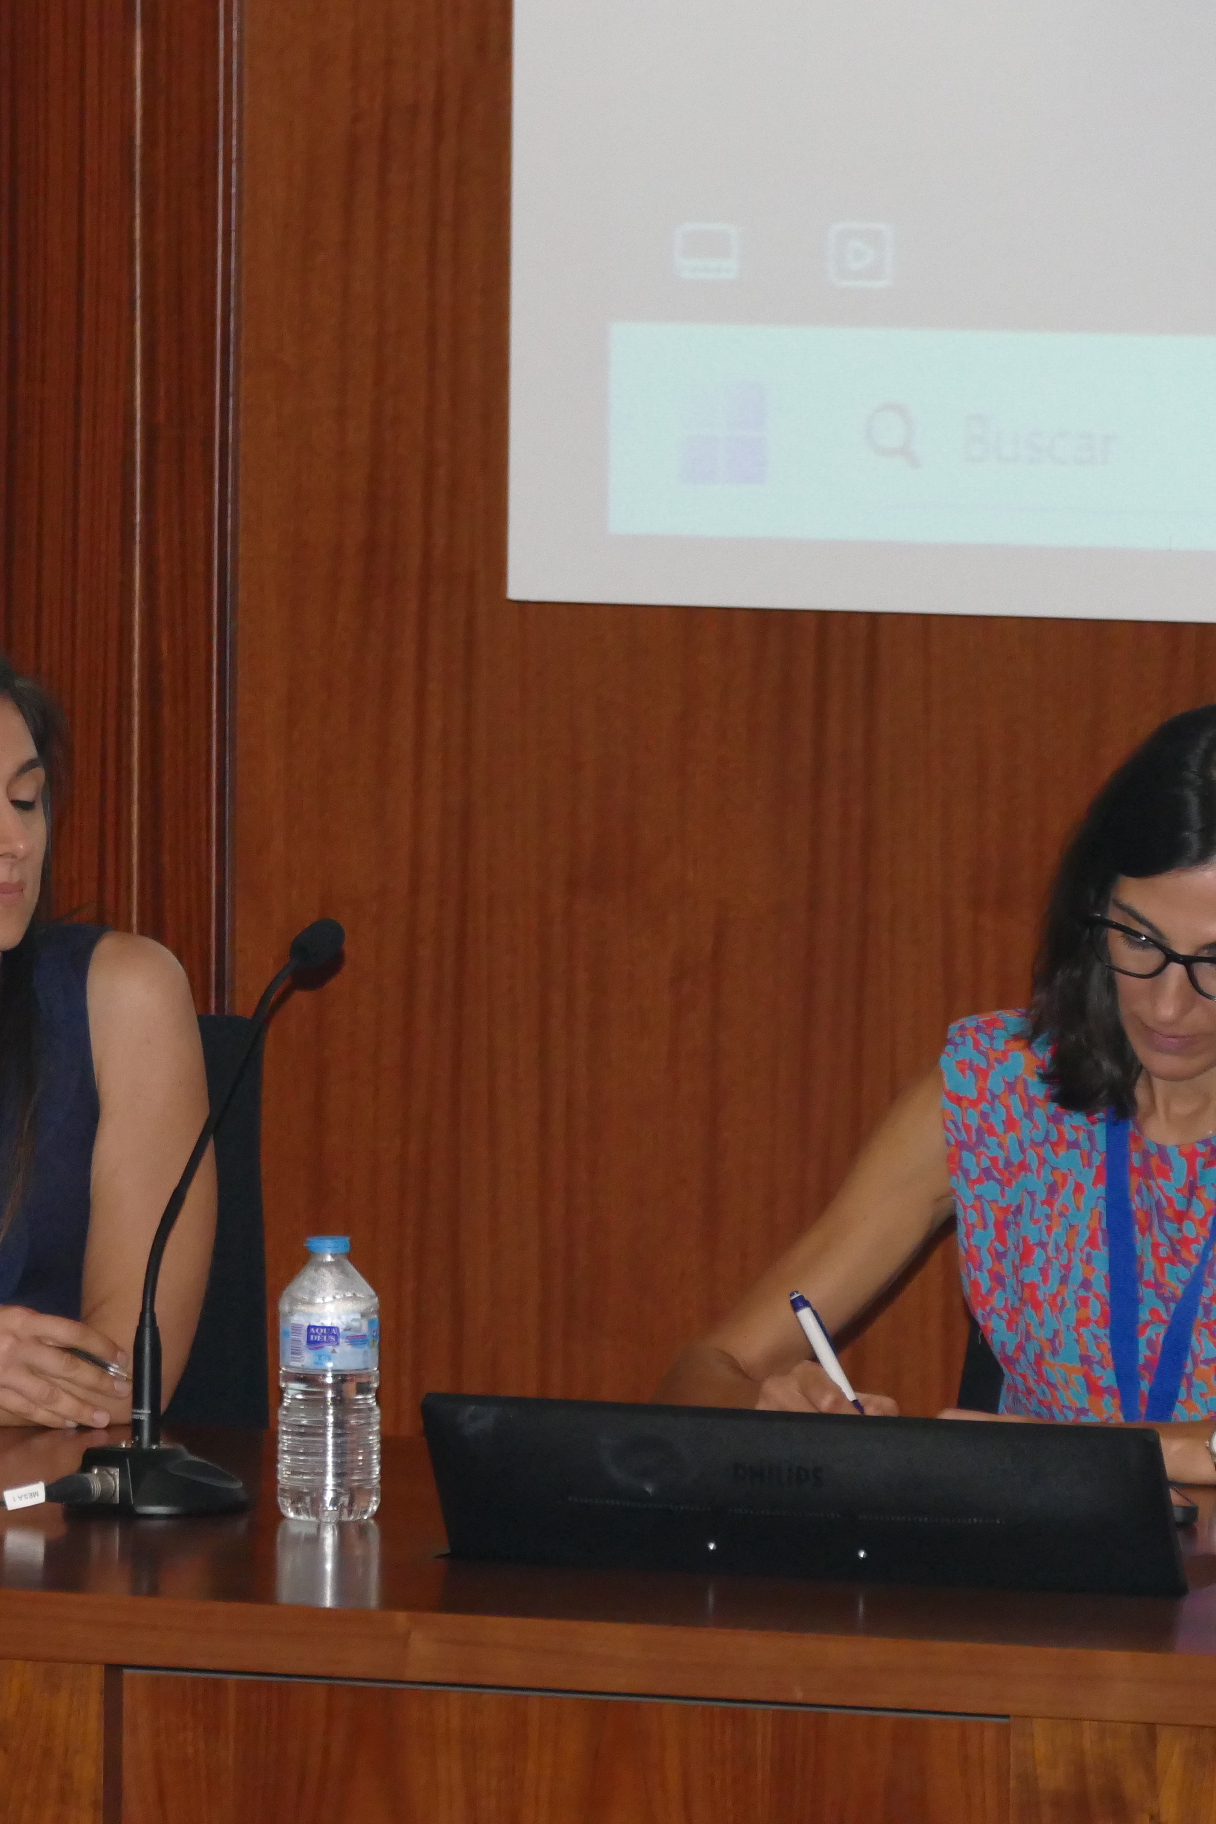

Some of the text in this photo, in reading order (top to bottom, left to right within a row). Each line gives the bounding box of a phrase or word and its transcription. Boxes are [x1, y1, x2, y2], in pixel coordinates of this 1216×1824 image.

[963, 413, 1120, 466] Buscar
[309, 1327, 337, 1335] AQUA
[733, 1462, 823, 1488] PHILIPS
[17, 1491, 39, 1502] MESA
